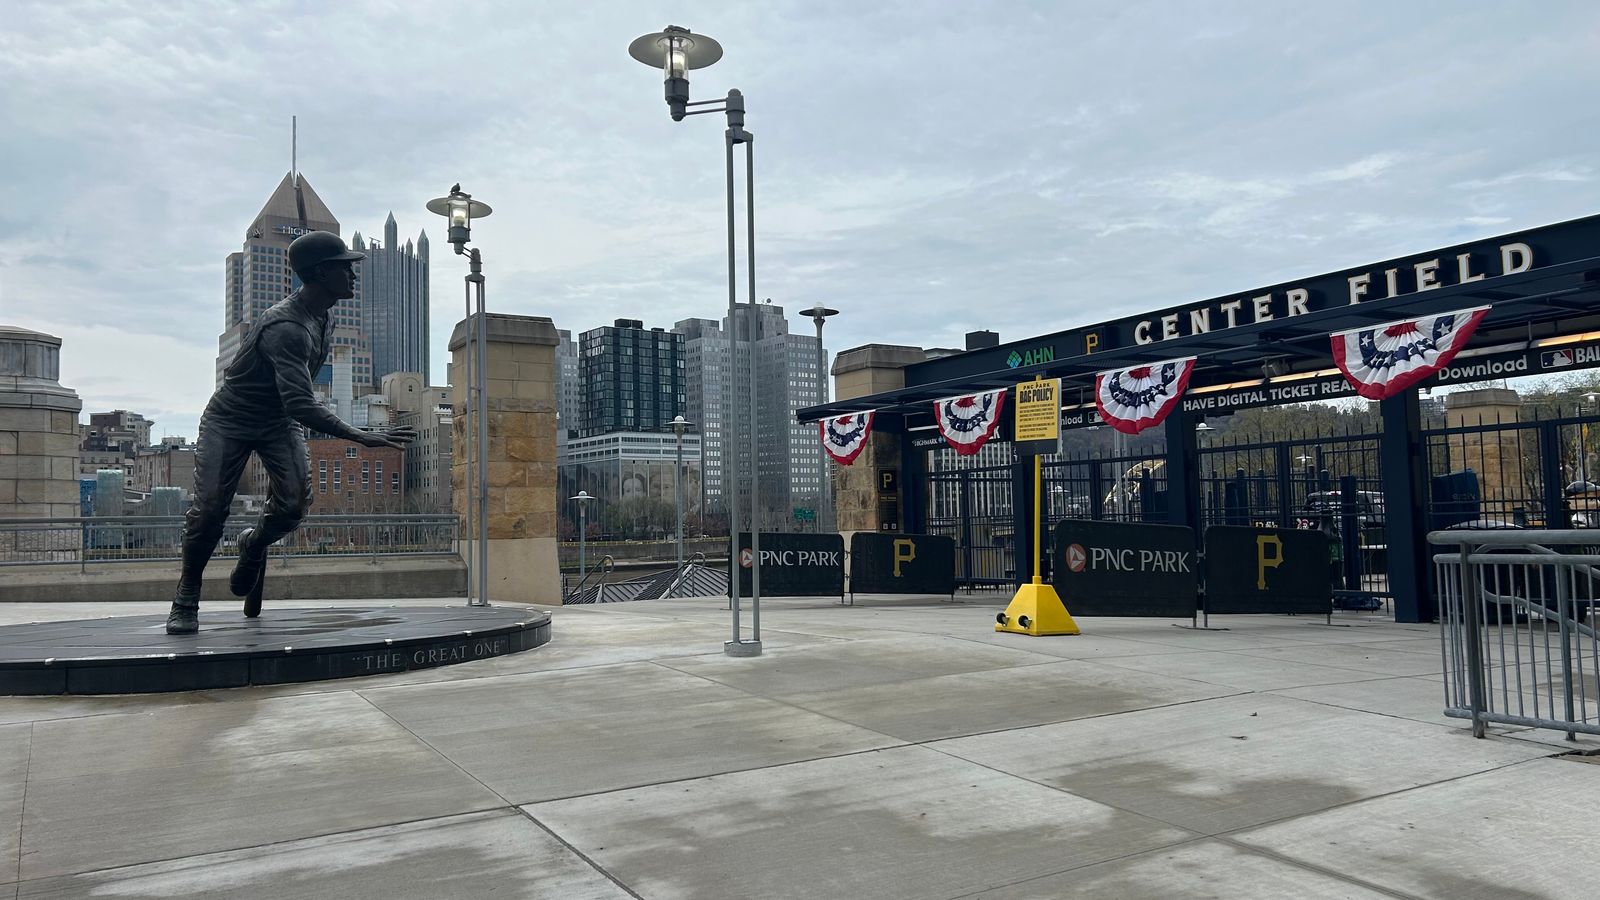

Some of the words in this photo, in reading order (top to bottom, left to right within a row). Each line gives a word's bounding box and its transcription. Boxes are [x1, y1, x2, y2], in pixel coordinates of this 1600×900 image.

[1134, 288, 1311, 345] CENTER
[1347, 242, 1533, 305] FIELD
[1024, 345, 1054, 366] AHN
[1085, 333, 1099, 355] P
[1438, 354, 1528, 381] Download
[1019, 390, 1031, 403] BAG
[1032, 388, 1054, 402] POLICY
[1183, 397, 1215, 412] HAVE
[1217, 390, 1267, 407] DIGITAL
[1269, 383, 1318, 400] TICKET
[1321, 379, 1356, 395] REA
[759, 550, 795, 566] PNC
[798, 551, 840, 566] PARK
[893, 538, 916, 578] P
[1090, 547, 1134, 571] PNC
[1139, 549, 1191, 573] PARK
[1256, 534, 1284, 590] P
[413, 644, 468, 665] GREAT
